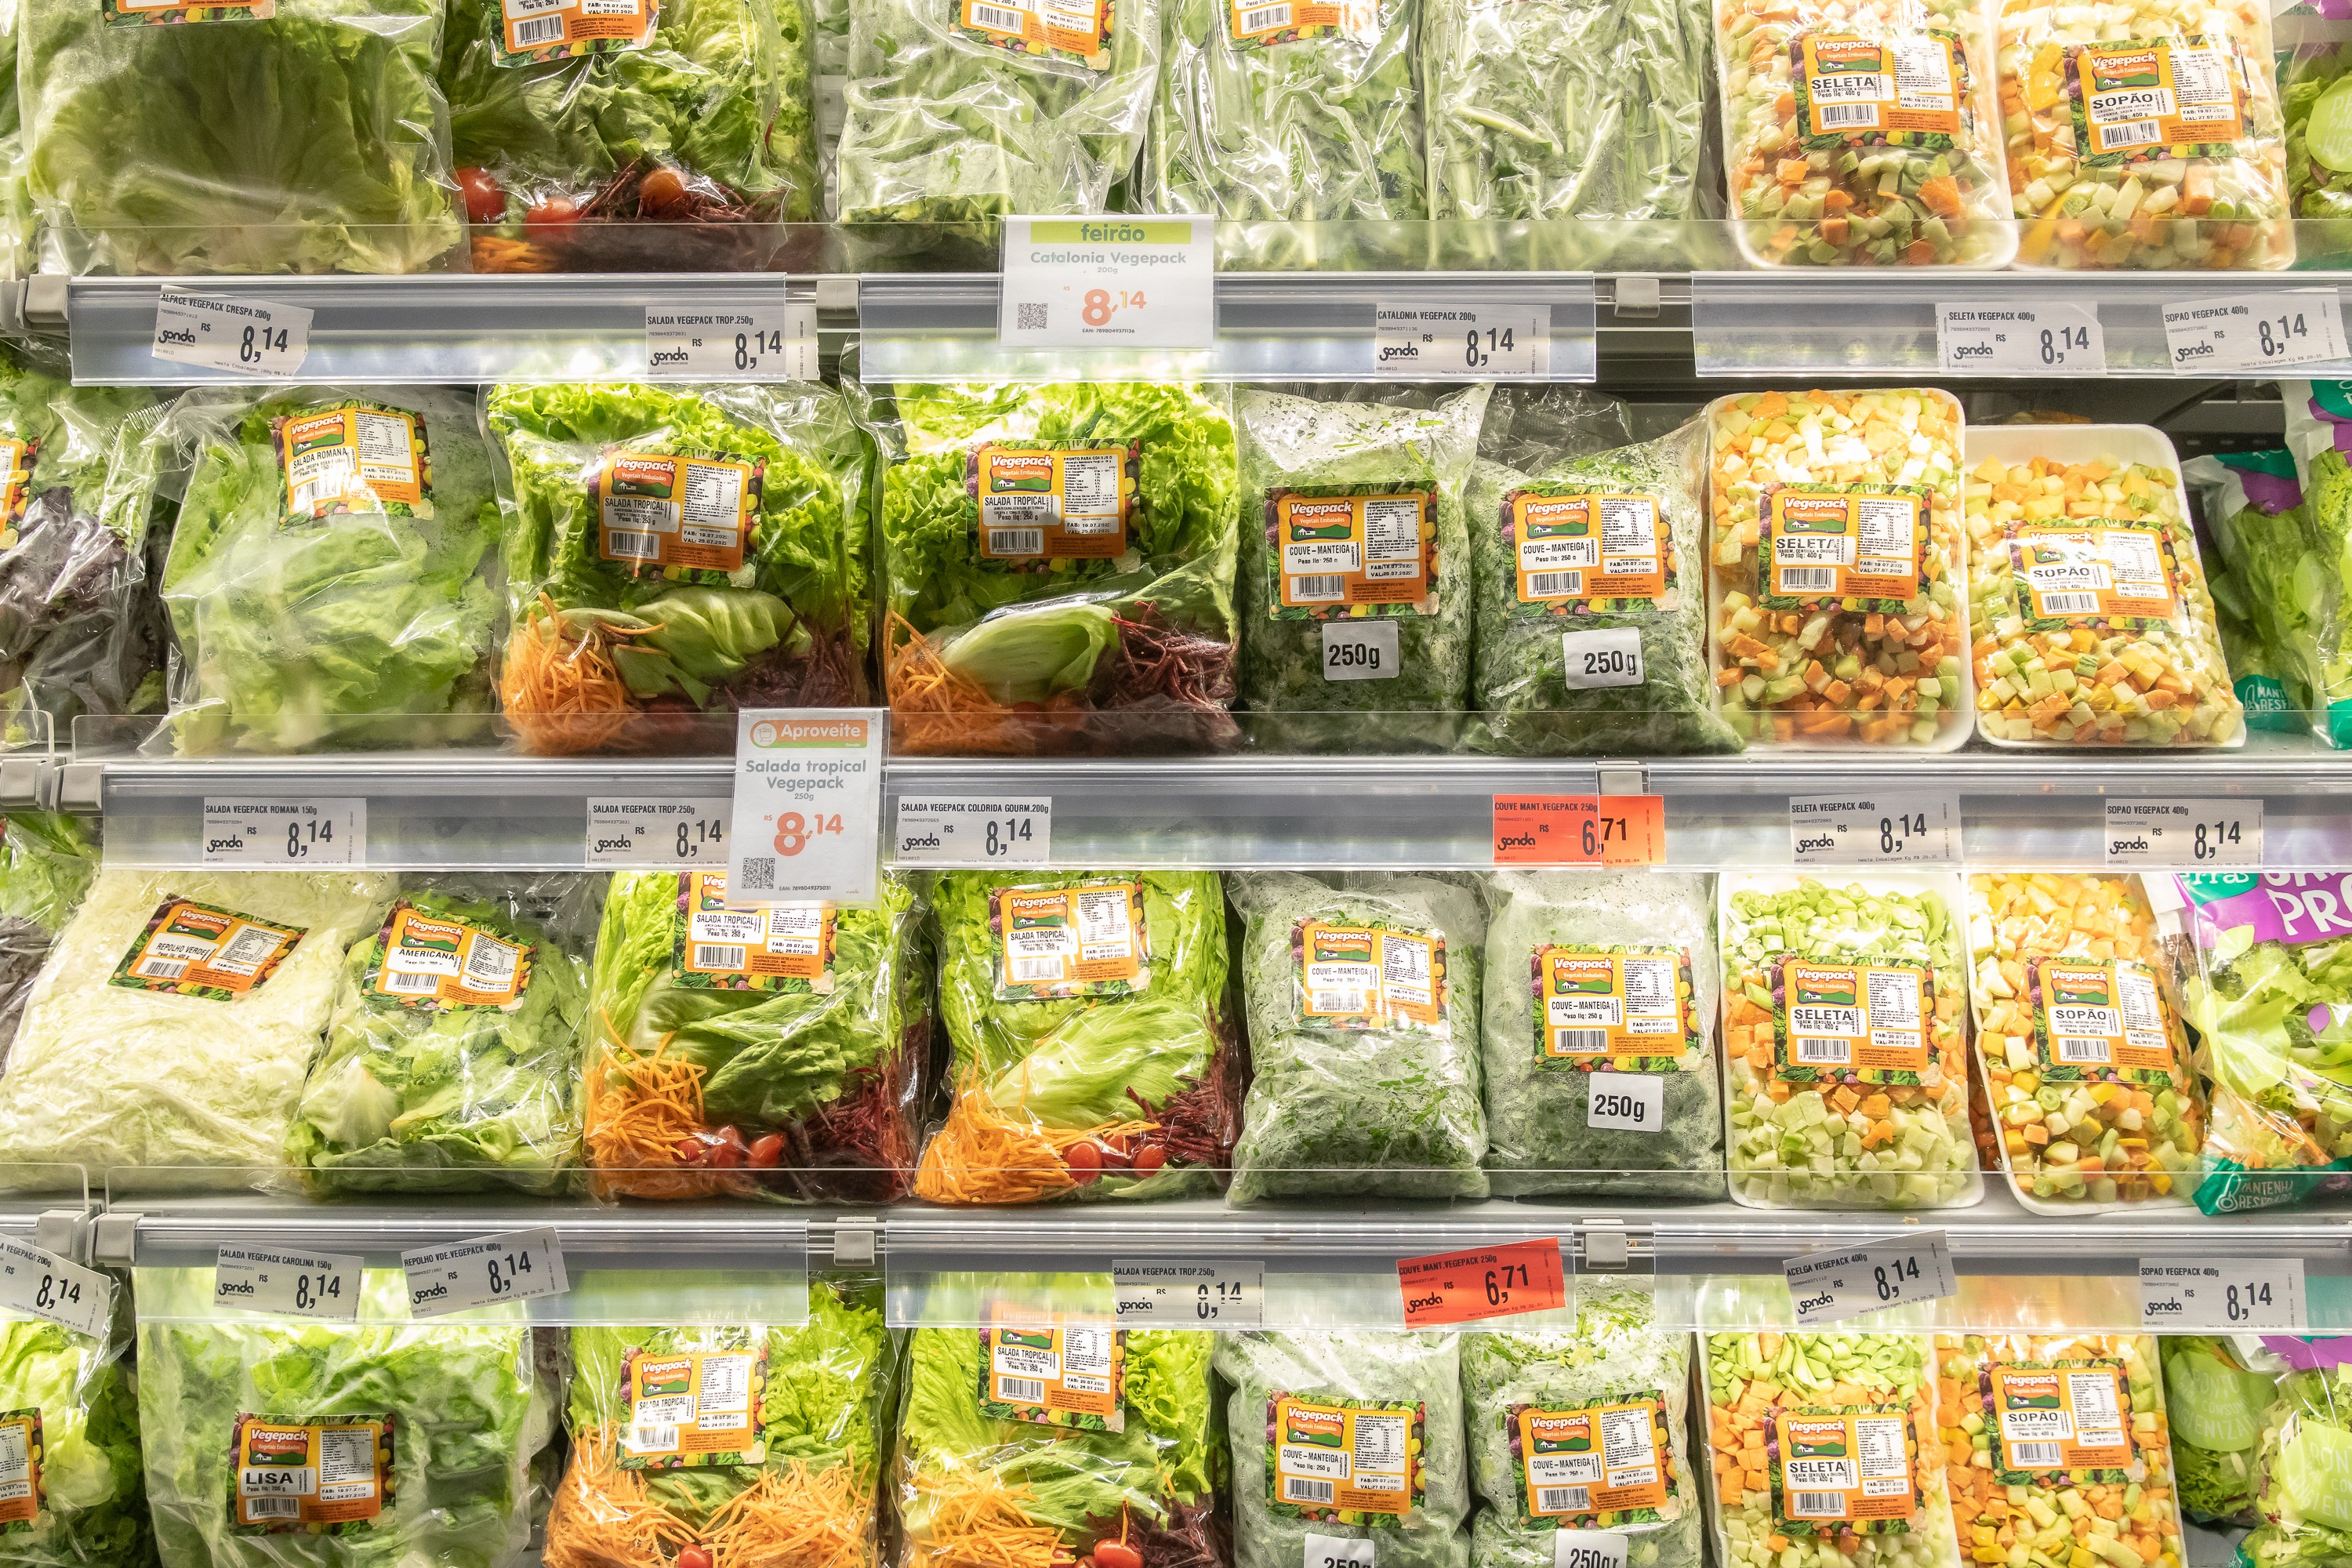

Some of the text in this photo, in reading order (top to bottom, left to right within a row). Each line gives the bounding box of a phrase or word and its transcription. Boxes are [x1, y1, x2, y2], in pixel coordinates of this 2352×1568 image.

[2091, 52, 2158, 67] Vegepack
[1811, 78, 1875, 89] SELETA
[2093, 93, 2153, 109] SOPÃO
[1081, 223, 1145, 241] feirão
[1031, 252, 1185, 266] Catalonia Vegepack
[161, 293, 270, 321] ALFACE VEGEPACK CRESPA 200g
[1082, 289, 1146, 326] 8,14
[2165, 306, 2248, 322] SOPAO VEGEPACK 400g
[648, 316, 674, 325] SALADA
[677, 316, 713, 325] VEGEPACK
[1378, 311, 1476, 322] CATALONIA VEGEPACK 200g
[2017, 313, 2034, 321] 400g
[201, 323, 211, 332] R$
[2259, 314, 2307, 356] 8,14
[240, 326, 288, 362] 8,14
[1423, 334, 1432, 343] R$
[2041, 326, 2089, 364] 8,14
[735, 330, 782, 370] 8,14
[1466, 328, 1514, 367] 8,14
[291, 413, 344, 434] Vegepack
[293, 448, 347, 469] SALADA ROMANA
[616, 458, 676, 471] Vegepack
[605, 498, 664, 510] SALADA TROPICAL
[985, 497, 1011, 506] SALADA
[1290, 501, 1354, 514] Vegepack
[1777, 538, 1837, 548] SELETA
[2033, 567, 2090, 578] SOPÃO
[1328, 643, 1381, 670] 250g
[1584, 650, 1637, 677] 250g
[781, 724, 861, 740] Aproveite
[746, 760, 866, 775] Salada tropical
[767, 776, 844, 792] Vegepack
[302, 806, 317, 815] 150g
[931, 804, 965, 812] VEGEPACK
[968, 804, 1002, 812] COLORIDA
[1581, 803, 1597, 812] 250g
[1792, 804, 1817, 813] SELETA
[1820, 802, 1856, 811] VEGEPACK
[2134, 806, 2169, 815] VEGEPACK
[2172, 807, 2189, 815] 400g
[288, 820, 332, 857] 8,14
[677, 819, 721, 857] 8,14
[774, 811, 844, 856] 8,14
[986, 818, 1032, 855] 8,14
[1881, 813, 1926, 853] 8,14
[2194, 821, 2241, 859] 8,14
[408, 916, 465, 936] Vegepack
[697, 914, 754, 924] SALADA TROPICAL
[1011, 930, 1065, 941] SALADA TROPICAL
[156, 942, 206, 956] REPOLHO VERDE
[399, 949, 455, 960] AMERICANA
[1554, 958, 1613, 971] Vegepack
[1795, 1009, 1853, 1020] SELETA
[2056, 1009, 2107, 1020] SOPÃO
[1594, 1094, 1645, 1122] 250g
[37, 1256, 52, 1268] 200g
[220, 1249, 332, 1270] SALADA VEGEPACK CAROLINA 150g
[404, 1255, 434, 1267] REPOLHO
[1788, 1254, 1867, 1276] ACELGA VEGEPACK 400g
[488, 1250, 532, 1294] 8,14
[1874, 1257, 1919, 1301] 8,14
[2203, 1268, 2219, 1277] 400g
[36, 1274, 81, 1310] 8,14
[296, 1274, 340, 1308] 8,14
[1486, 1264, 1528, 1305] 6,71
[2227, 1283, 2272, 1320] 8,14
[998, 1347, 1049, 1361] SALADA TROPICAL
[662, 1397, 686, 1406] TROPICAL
[1531, 1414, 1591, 1429] Vegepack
[2009, 1411, 2058, 1422] SOPÃO
[251, 1429, 309, 1442] Vegepack
[1790, 1461, 1846, 1472] SELETA
[246, 1472, 293, 1484] LISA
